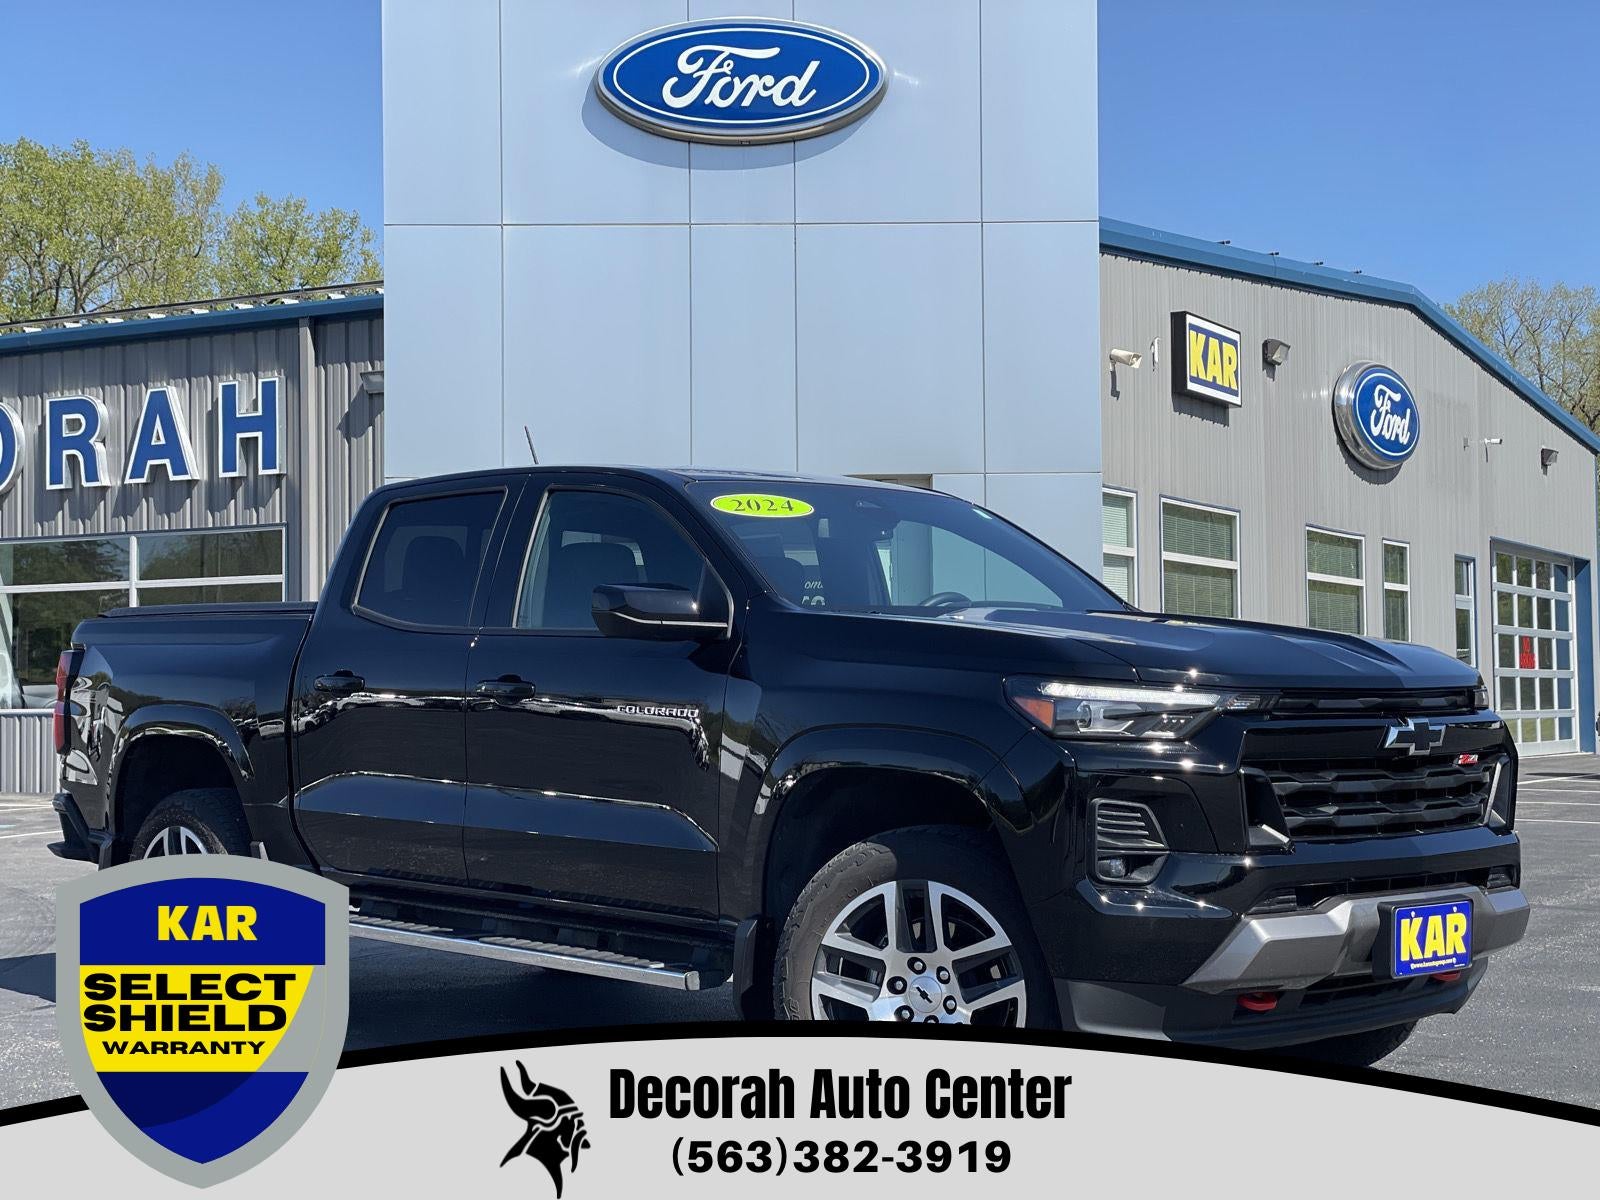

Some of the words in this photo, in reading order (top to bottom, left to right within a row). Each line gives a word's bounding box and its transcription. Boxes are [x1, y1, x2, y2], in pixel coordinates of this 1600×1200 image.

[662, 44, 821, 108] Ford
[1189, 330, 1238, 391] KAR
[1371, 384, 1410, 445] Ford
[731, 498, 795, 513] 2024
[617, 705, 700, 718] COLORADO
[1401, 913, 1467, 961] KAR
